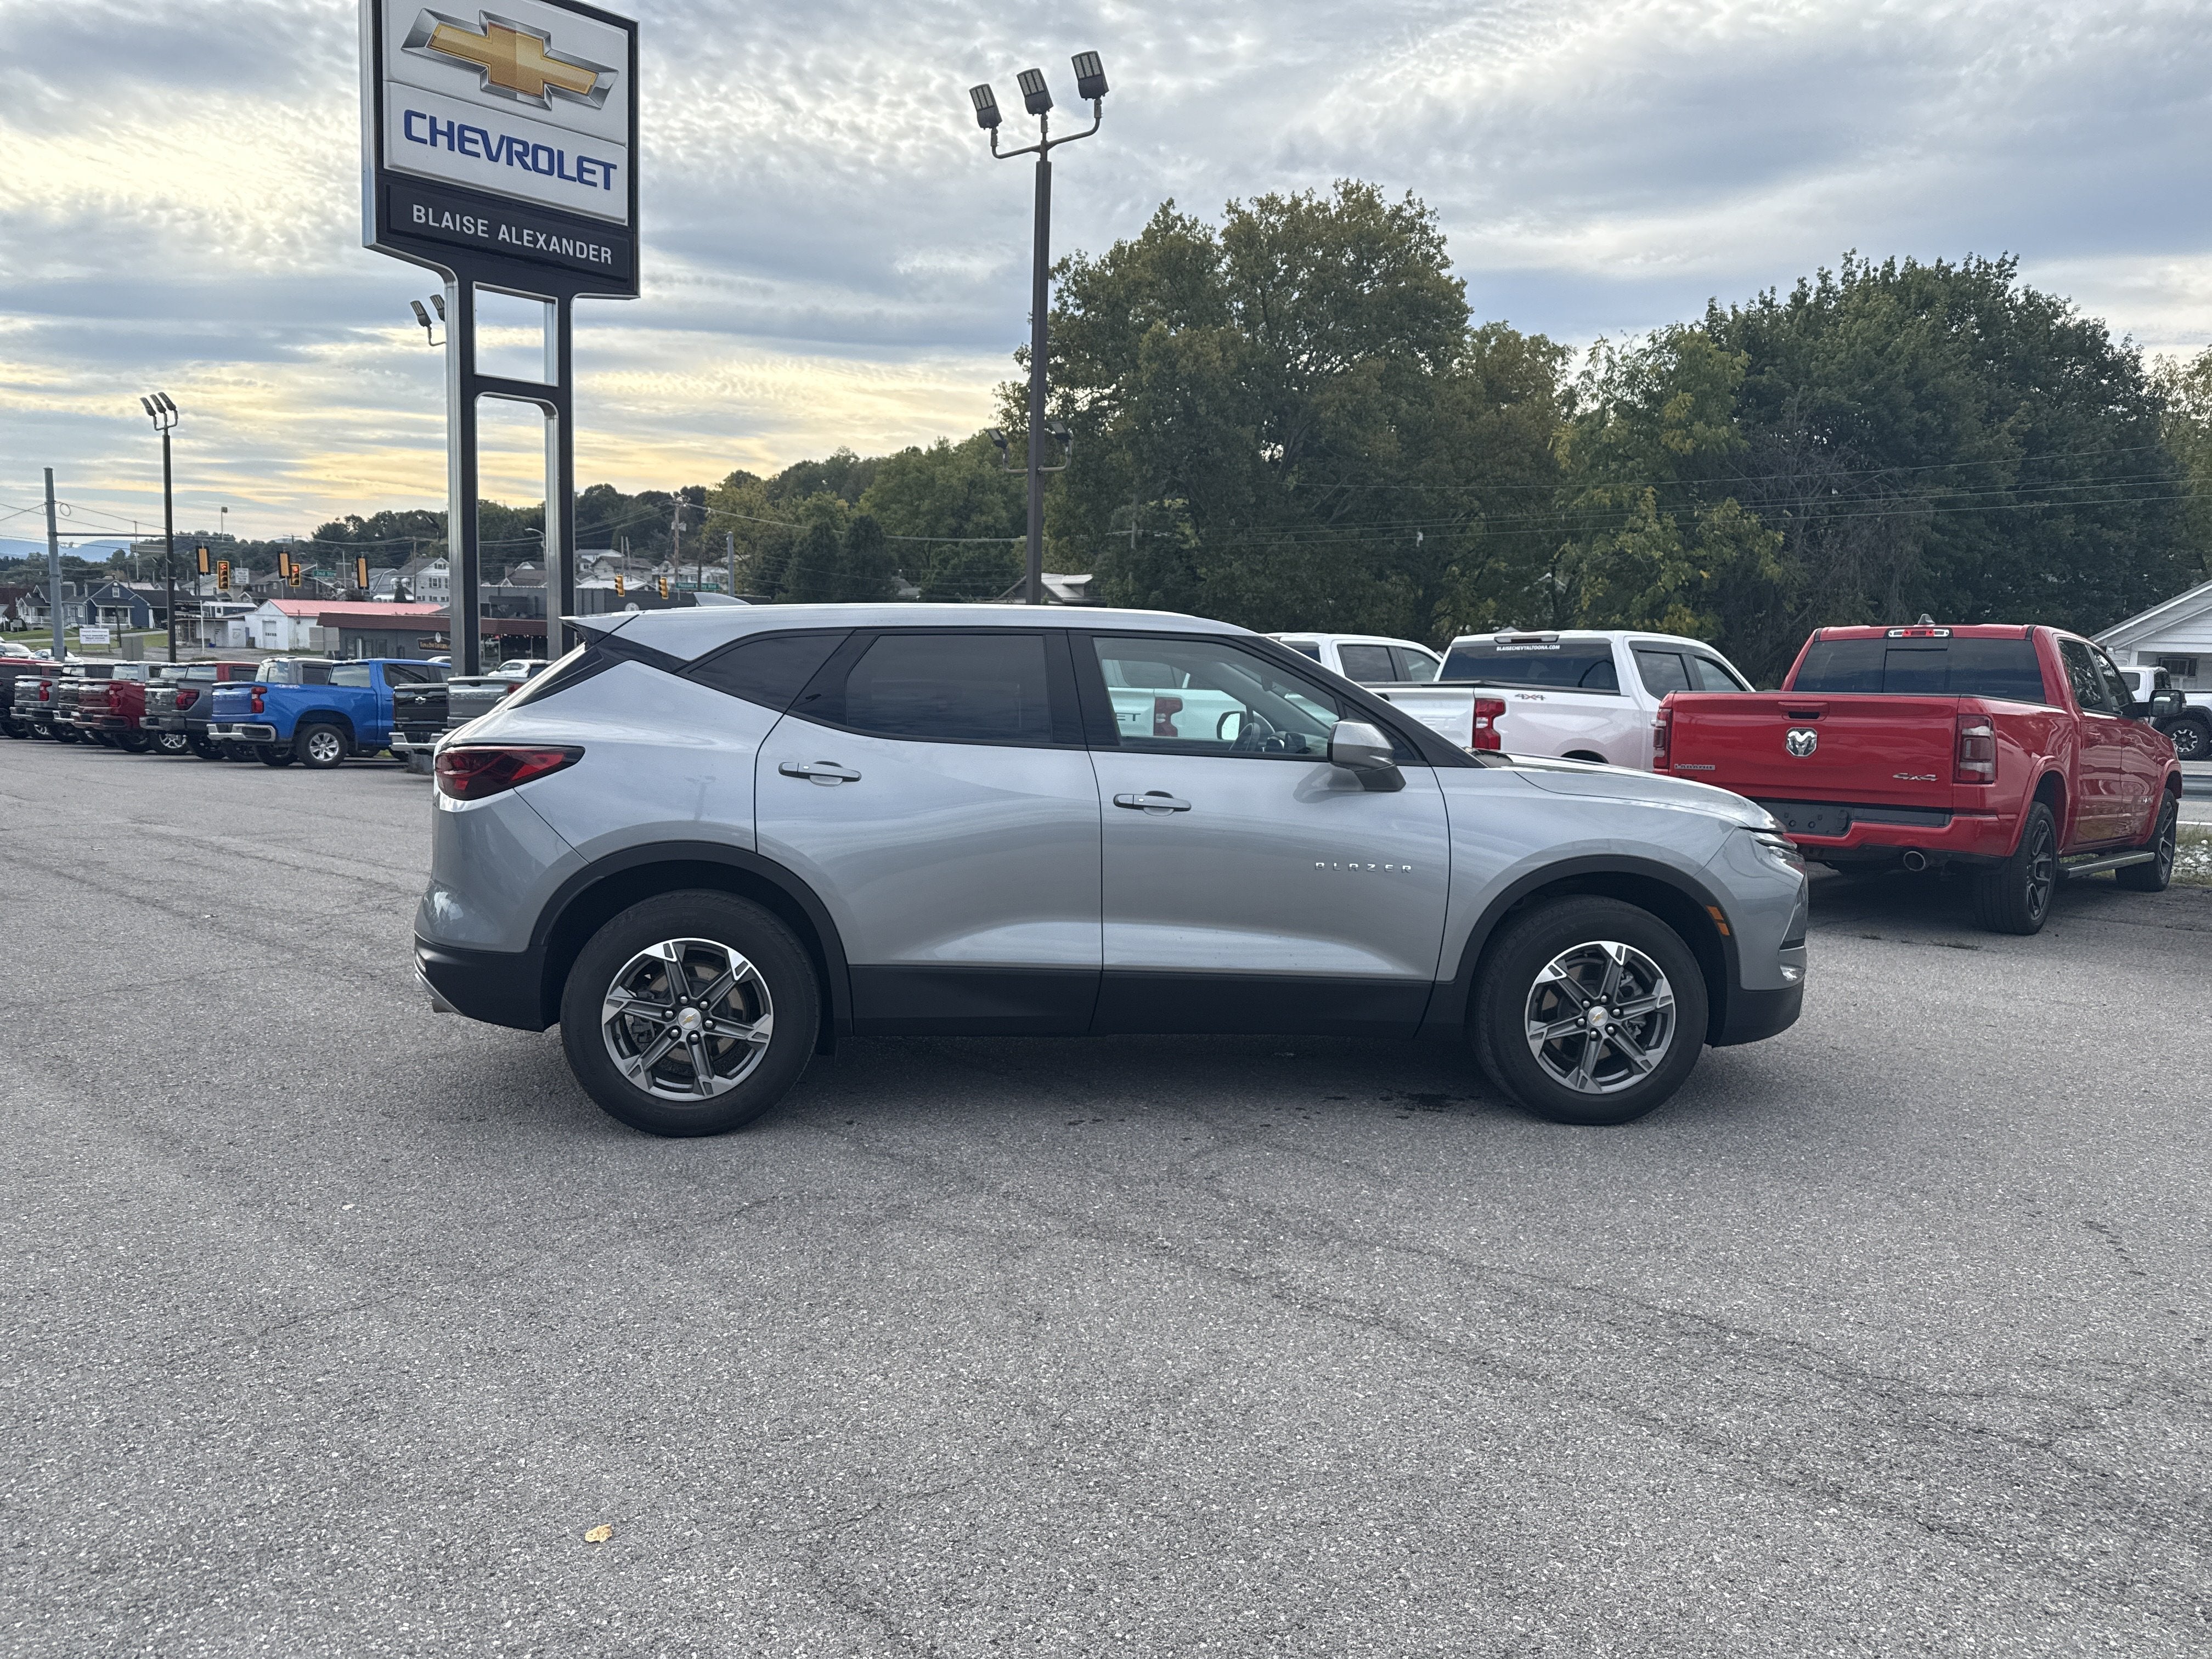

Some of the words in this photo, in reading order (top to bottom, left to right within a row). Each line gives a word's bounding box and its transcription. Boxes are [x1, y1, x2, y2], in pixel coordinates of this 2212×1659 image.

[404, 110, 617, 190] CHEVROLET
[413, 204, 489, 238] BLAISE
[497, 224, 612, 264] ALEXANDER
[1315, 862, 1412, 873] BLAZER
